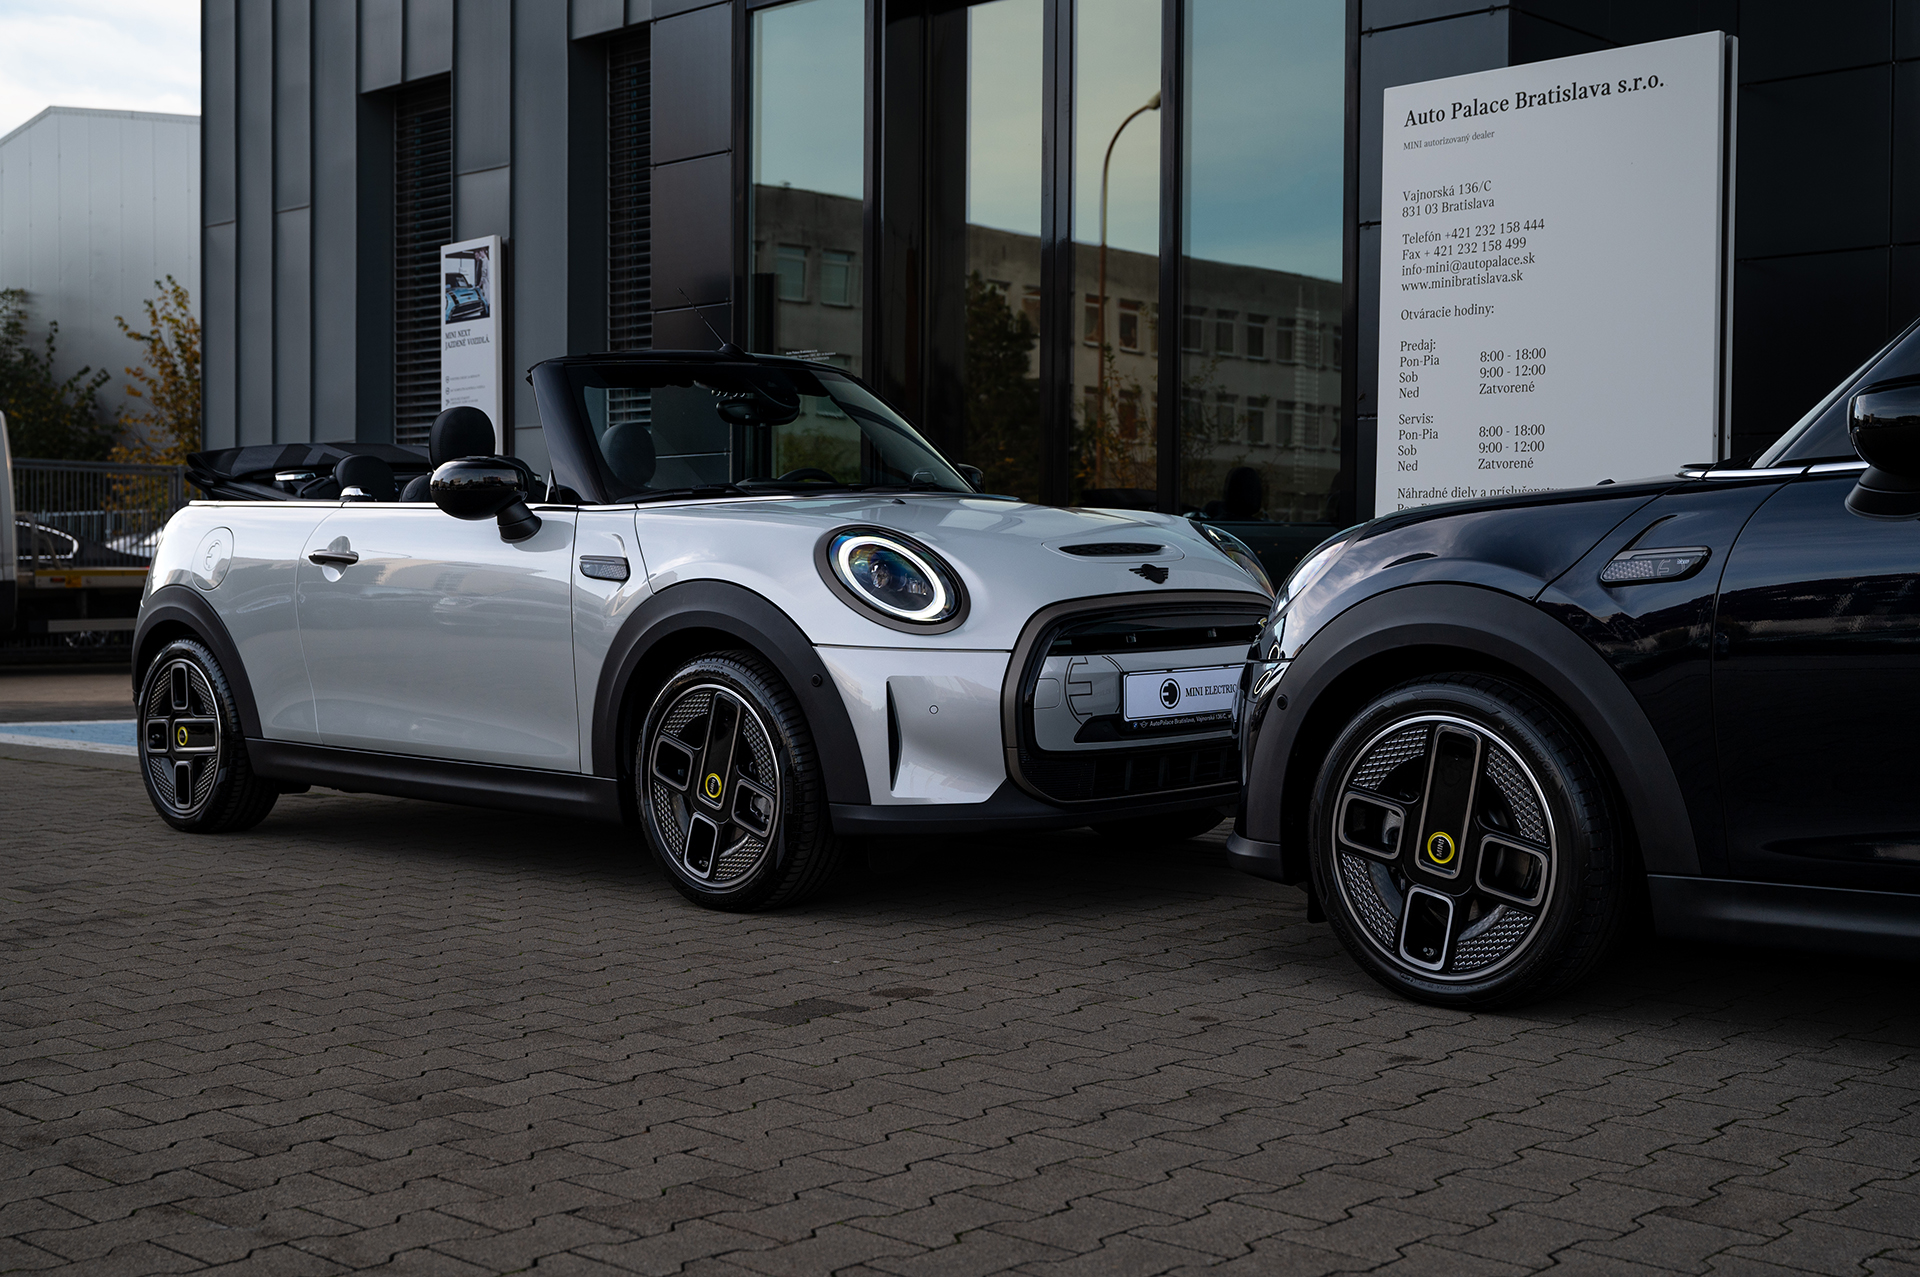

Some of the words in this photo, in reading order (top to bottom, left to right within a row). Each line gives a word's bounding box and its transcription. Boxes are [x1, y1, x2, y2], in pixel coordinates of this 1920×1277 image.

[1404, 108, 1445, 127] Auto
[1450, 97, 1509, 120] Palace
[1514, 81, 1612, 109] Bratislava
[1617, 73, 1665, 93] s.r.o.
[1403, 140, 1422, 150] MINI
[1423, 133, 1470, 148] autorizovaný
[1471, 129, 1495, 141] dealer
[1402, 185, 1455, 203] Vajnorská
[1458, 180, 1492, 196] 136/C
[1402, 205, 1422, 218] 831
[1424, 203, 1439, 216] 03
[1441, 197, 1495, 213] Bratislava
[1402, 230, 1442, 245] Telefón
[1444, 226, 1472, 240] +421
[1475, 224, 1496, 238] 232
[1499, 221, 1521, 235] 158
[1523, 218, 1546, 232] 444
[1402, 248, 1421, 261] Fax
[1433, 245, 1454, 258] 421
[1457, 242, 1478, 255] 232
[1481, 240, 1502, 253] 158
[1505, 237, 1527, 250] 499
[1401, 253, 1535, 277] info-mini@autopalace.sk
[1401, 270, 1524, 291] www.minibratislava.sk
[1400, 304, 1452, 321] Otváracie
[1454, 303, 1494, 319] hodiny:
[1400, 339, 1436, 353] Predaj:
[1399, 354, 1440, 367] Pon-Pia
[1480, 350, 1504, 363] 8:00
[1515, 347, 1547, 361] 18:00
[1398, 371, 1419, 383] Sob
[1479, 366, 1504, 379] 9:00
[1514, 364, 1546, 377] 12:00
[1398, 387, 1420, 399] Ned
[1479, 381, 1535, 395] Zatvorené
[1398, 413, 1434, 425] Servis:
[1398, 429, 1439, 441] Pon-Pia
[1478, 425, 1503, 438] 8:00
[1514, 423, 1546, 437] 18:00
[1397, 445, 1418, 457] Sob
[1478, 441, 1503, 454] 9:00
[1513, 440, 1545, 453] 12:00
[1397, 460, 1419, 472] Ned
[1478, 456, 1534, 470] Zatvorené
[1397, 487, 1448, 499] Náhradné
[1185, 687, 1203, 698] MINI
